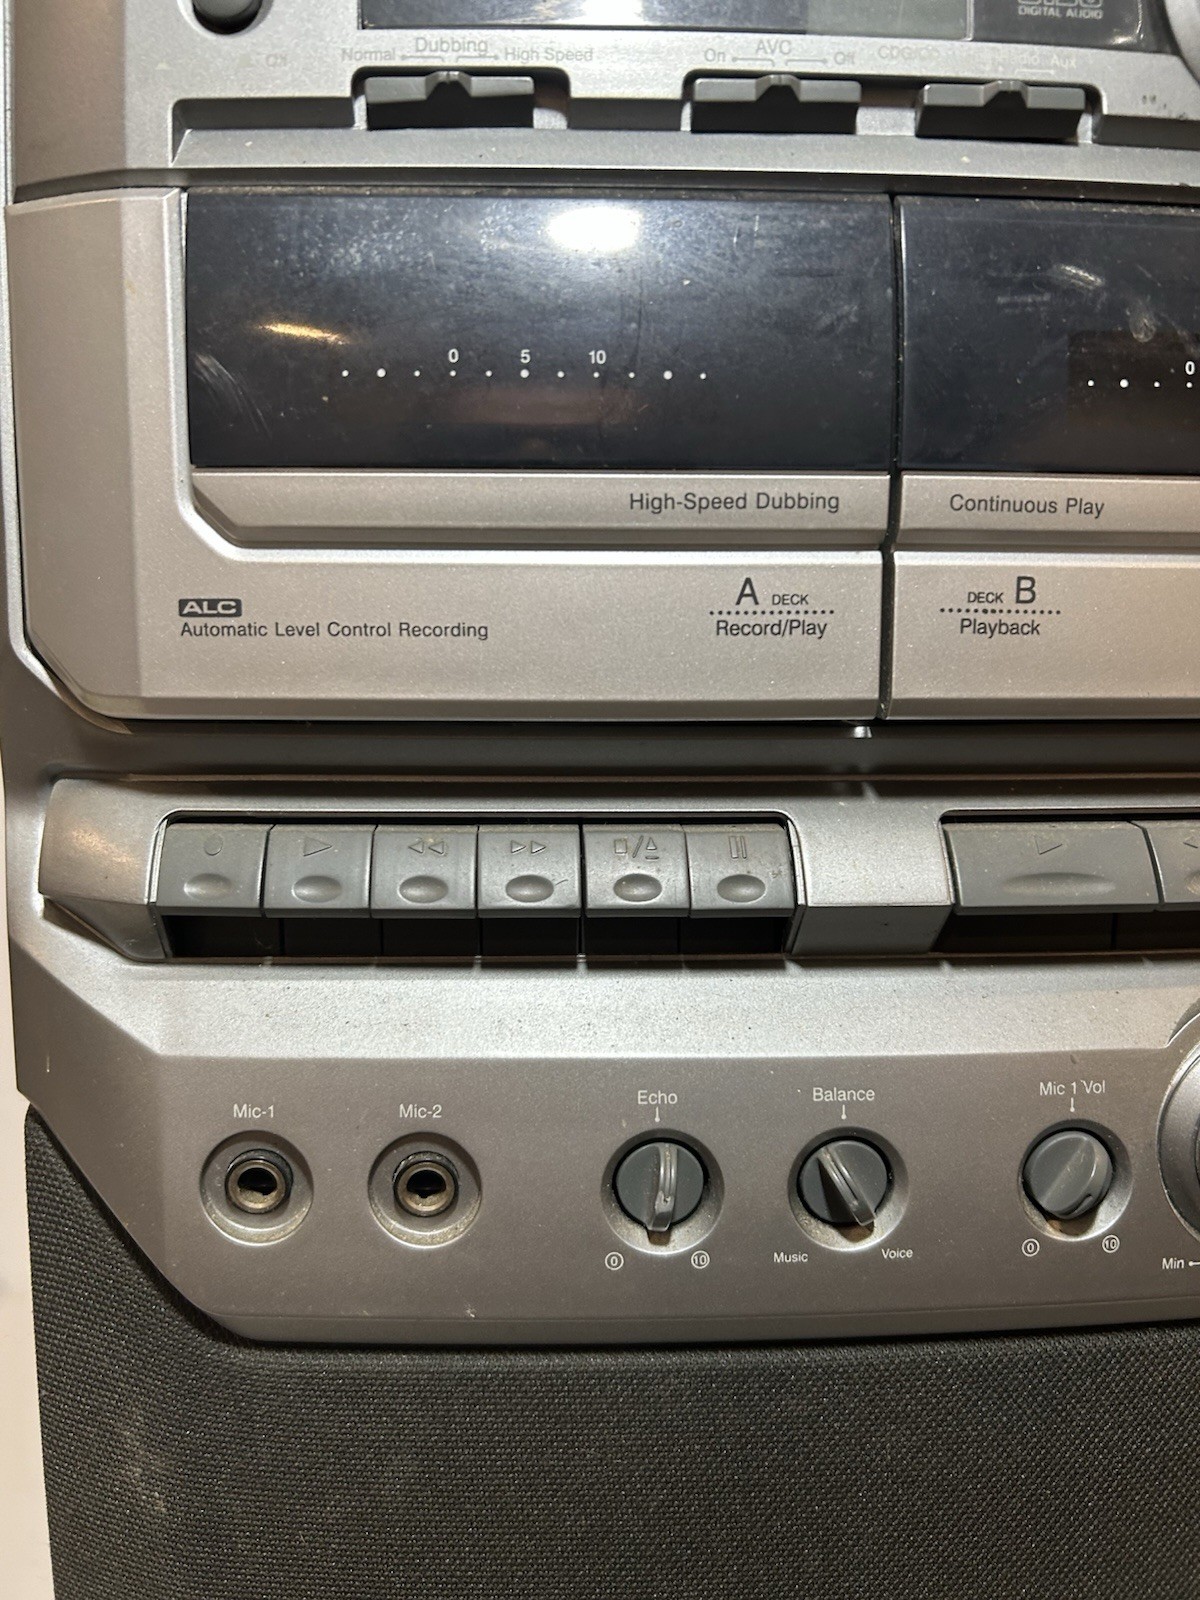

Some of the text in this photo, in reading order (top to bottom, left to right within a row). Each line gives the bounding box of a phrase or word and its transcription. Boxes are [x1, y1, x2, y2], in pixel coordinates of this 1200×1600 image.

[1018, 5, 1104, 20] DIGITAL AUDIO
[414, 37, 488, 53] Dubbing
[756, 40, 791, 55] AVC
[341, 47, 395, 62] Normal
[504, 47, 593, 63] High Speed
[704, 48, 726, 62] On
[833, 51, 855, 66] Off
[1050, 54, 1077, 69] Aux
[447, 349, 607, 364] 0 5 10
[1185, 360, 1195, 375] 0
[629, 492, 839, 514] High-Speed Dubbing
[950, 493, 1105, 519] Continuous Play
[735, 577, 809, 606] A DECK
[967, 575, 1037, 604] DECK B
[182, 601, 238, 614] ALC
[180, 622, 488, 641] Automatic Level Control Recording
[716, 619, 827, 640] Record/Play
[960, 618, 1041, 639] Playback
[812, 1087, 876, 1101] Balance
[1039, 1080, 1106, 1096] Mic 1 Vol
[637, 1090, 678, 1105] Echo
[233, 1104, 275, 1118] Mic-1
[399, 1104, 443, 1119] Mic-2
[773, 1252, 809, 1263] Music
[881, 1248, 914, 1259] Voice
[1161, 1258, 1185, 1270] Min
